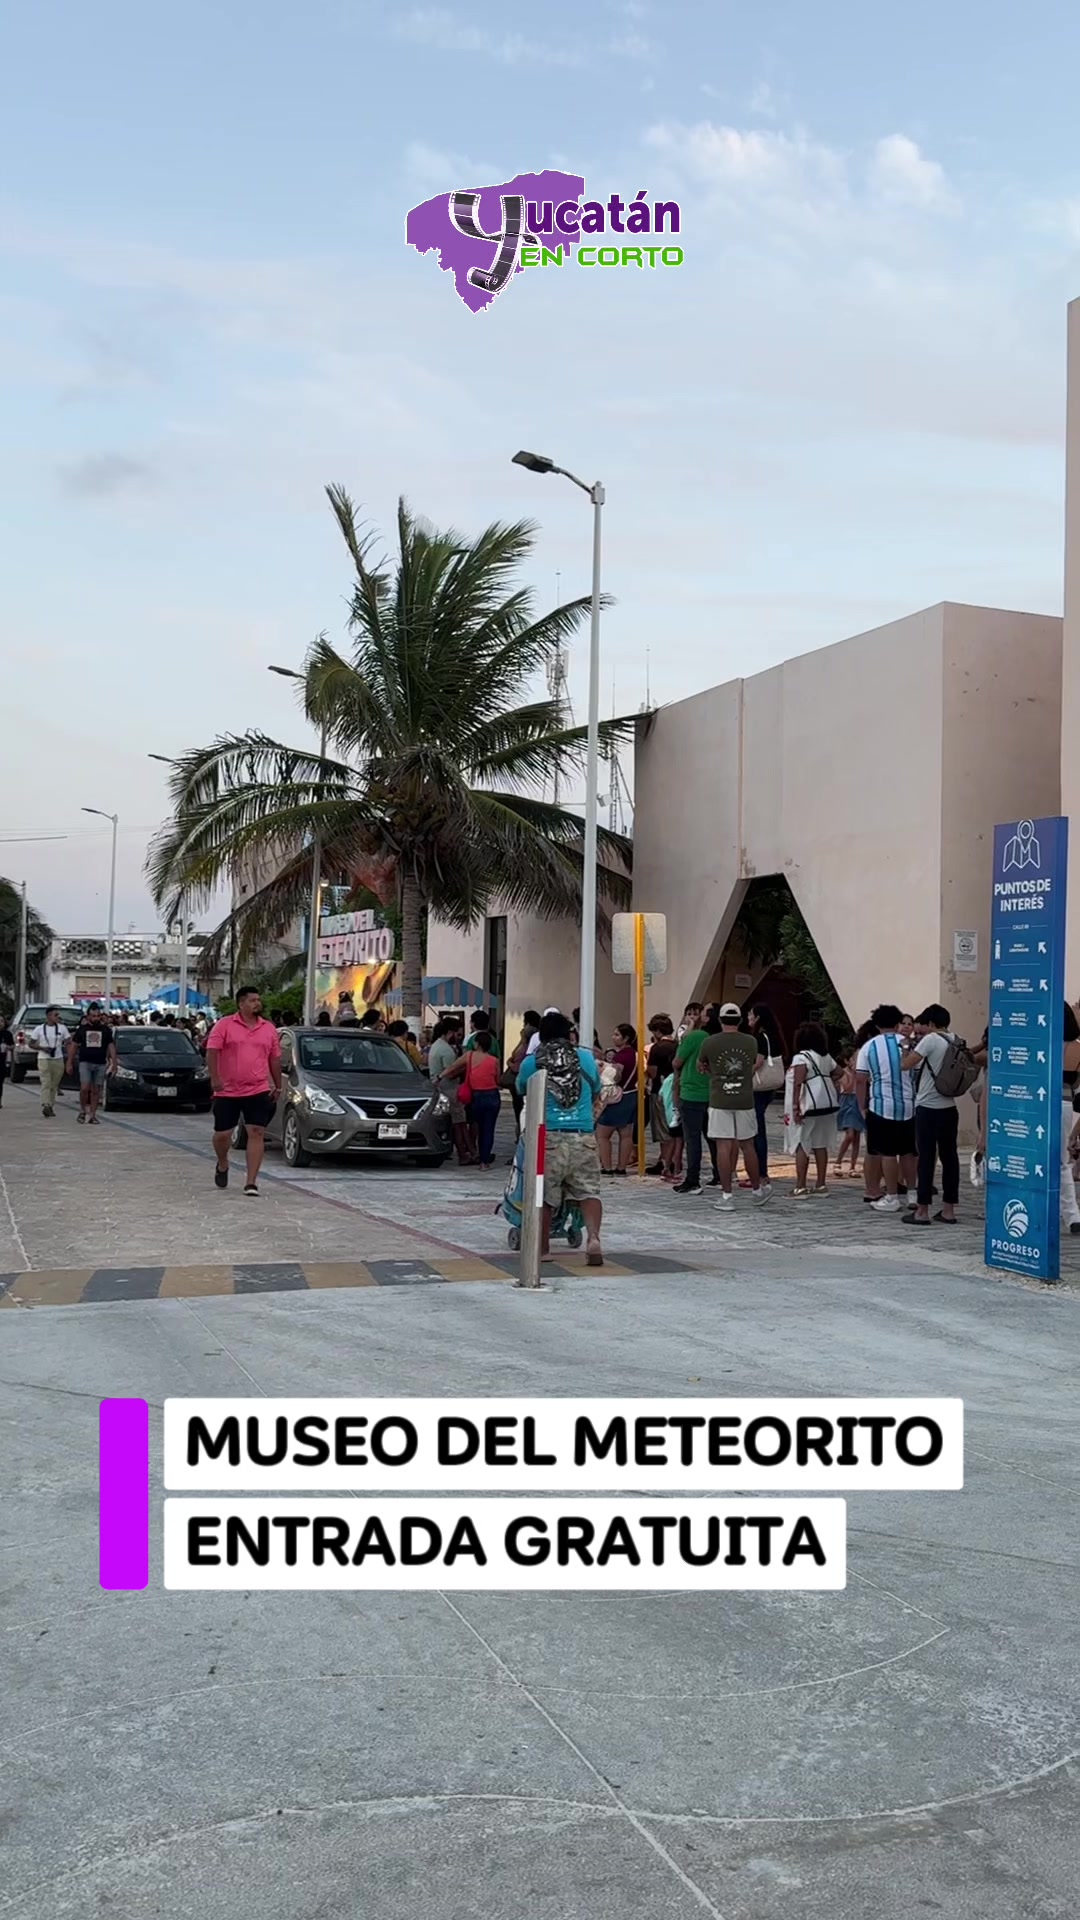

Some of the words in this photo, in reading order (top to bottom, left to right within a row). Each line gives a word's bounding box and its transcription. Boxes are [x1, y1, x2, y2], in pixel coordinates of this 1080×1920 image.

[994, 881, 1036, 896] PUNTOS
[1036, 878, 1052, 892] DE
[1000, 894, 1045, 912] INTERÉS
[353, 909, 377, 932] DEL
[316, 927, 394, 967] ETEORITO
[991, 1238, 1041, 1259] PROGRESO
